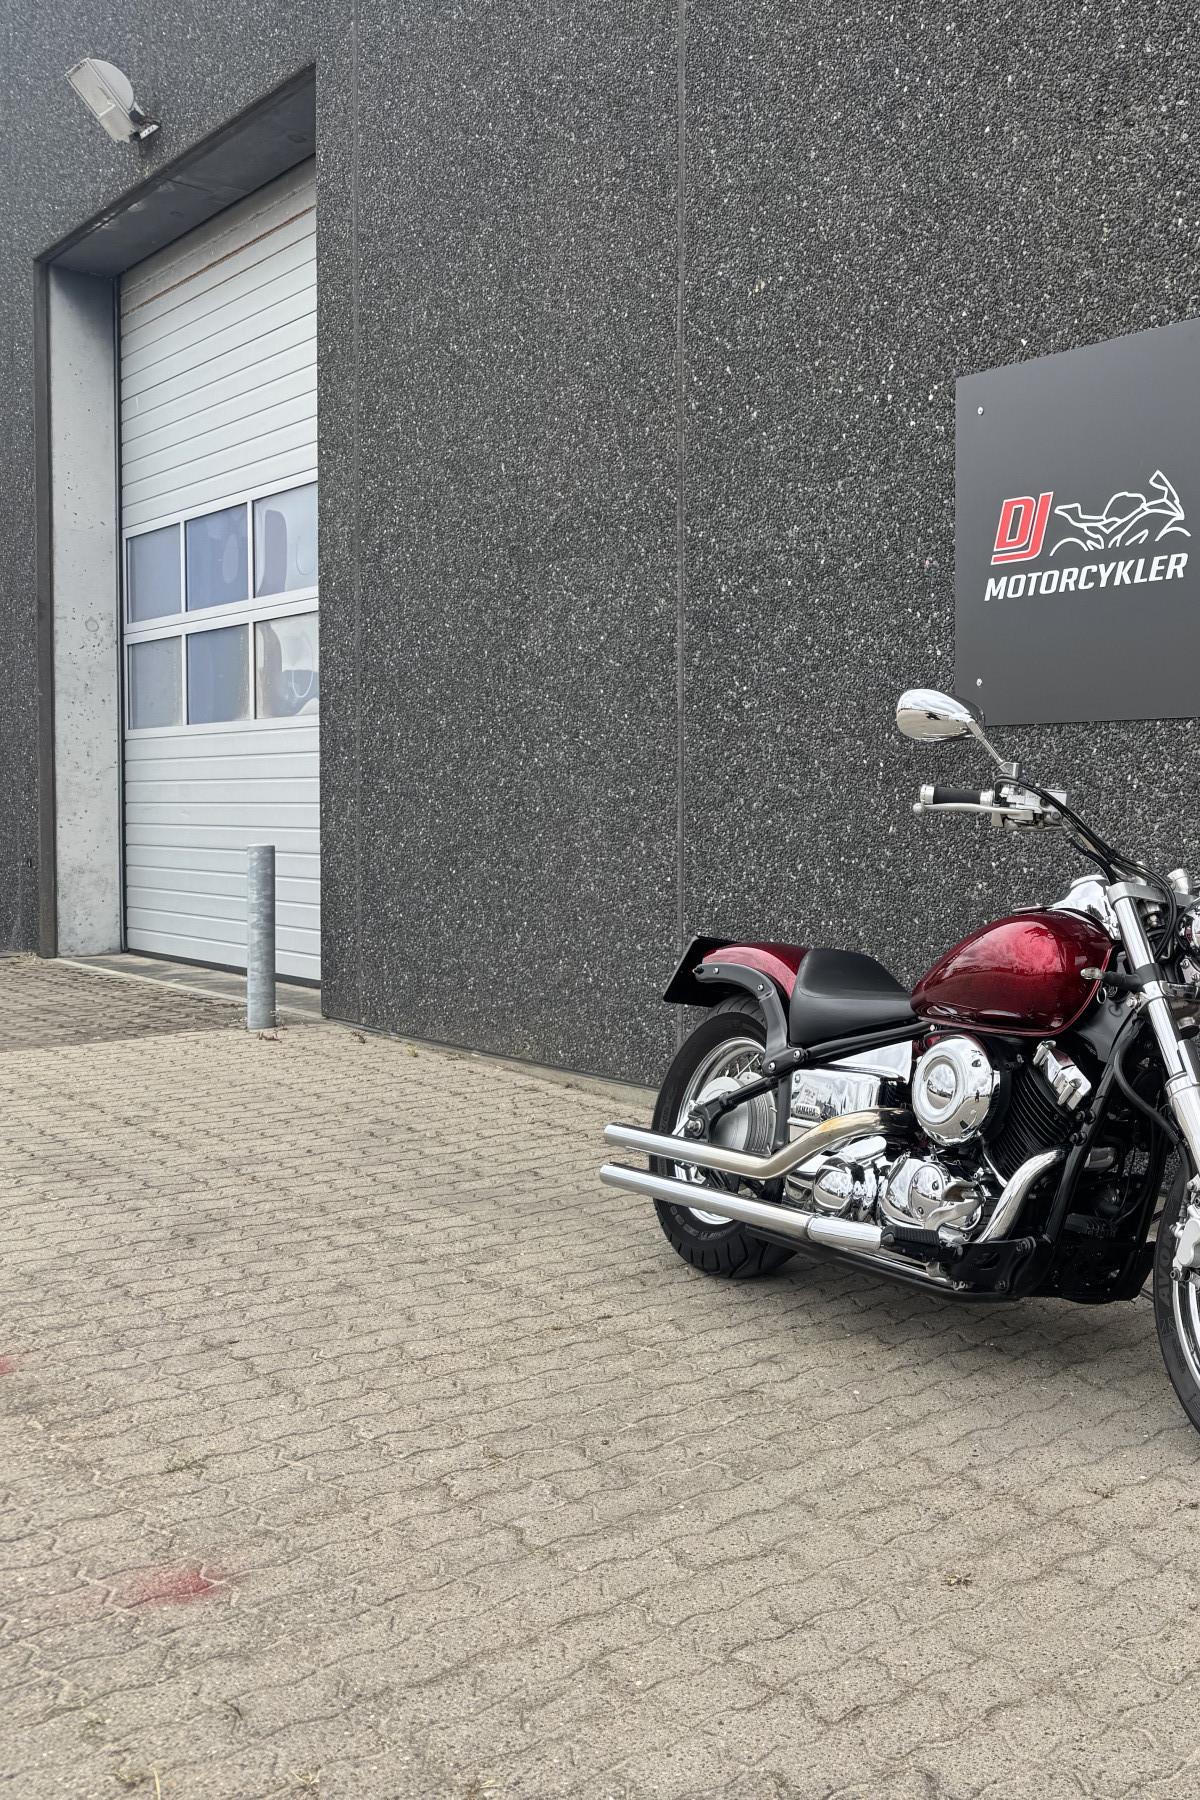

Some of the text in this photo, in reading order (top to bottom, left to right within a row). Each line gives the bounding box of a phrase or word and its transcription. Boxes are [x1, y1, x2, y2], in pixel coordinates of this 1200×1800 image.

[990, 491, 1054, 566] DJ
[983, 552, 1189, 602] MOTORCYKLER
[795, 1105, 816, 1116] YAMAHA
